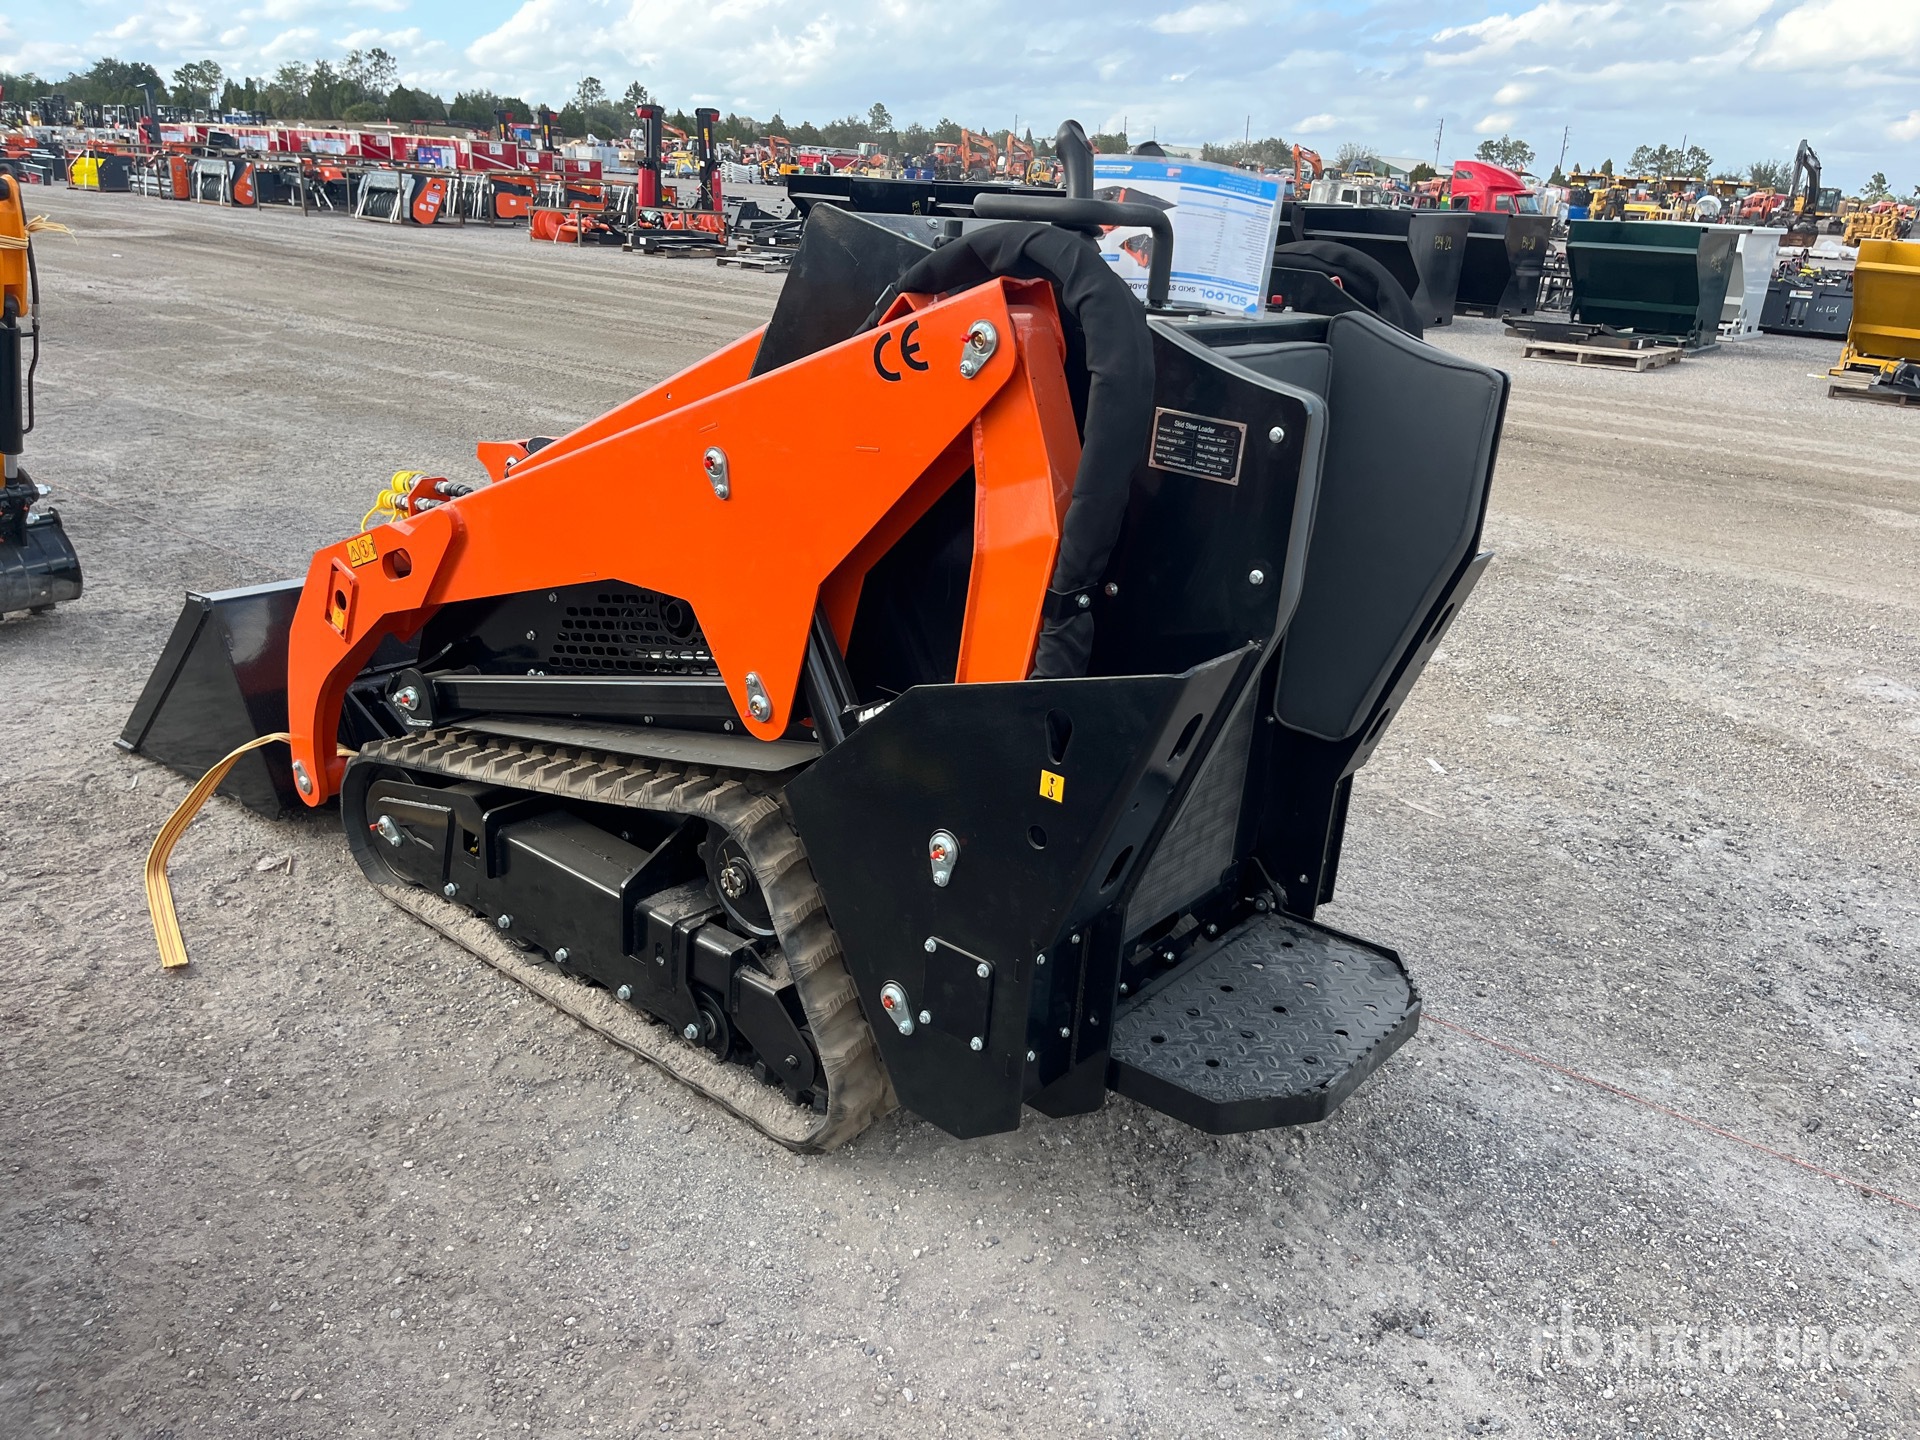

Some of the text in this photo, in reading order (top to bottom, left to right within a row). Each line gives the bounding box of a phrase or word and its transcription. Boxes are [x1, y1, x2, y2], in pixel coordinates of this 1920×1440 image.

[1178, 285, 1196, 293] SKID
[1199, 288, 1248, 306] SDLOOL
[873, 320, 929, 382] CE
[1174, 420, 1185, 429] Skid
[1185, 422, 1198, 432] Steer
[1198, 424, 1216, 434] Loader
